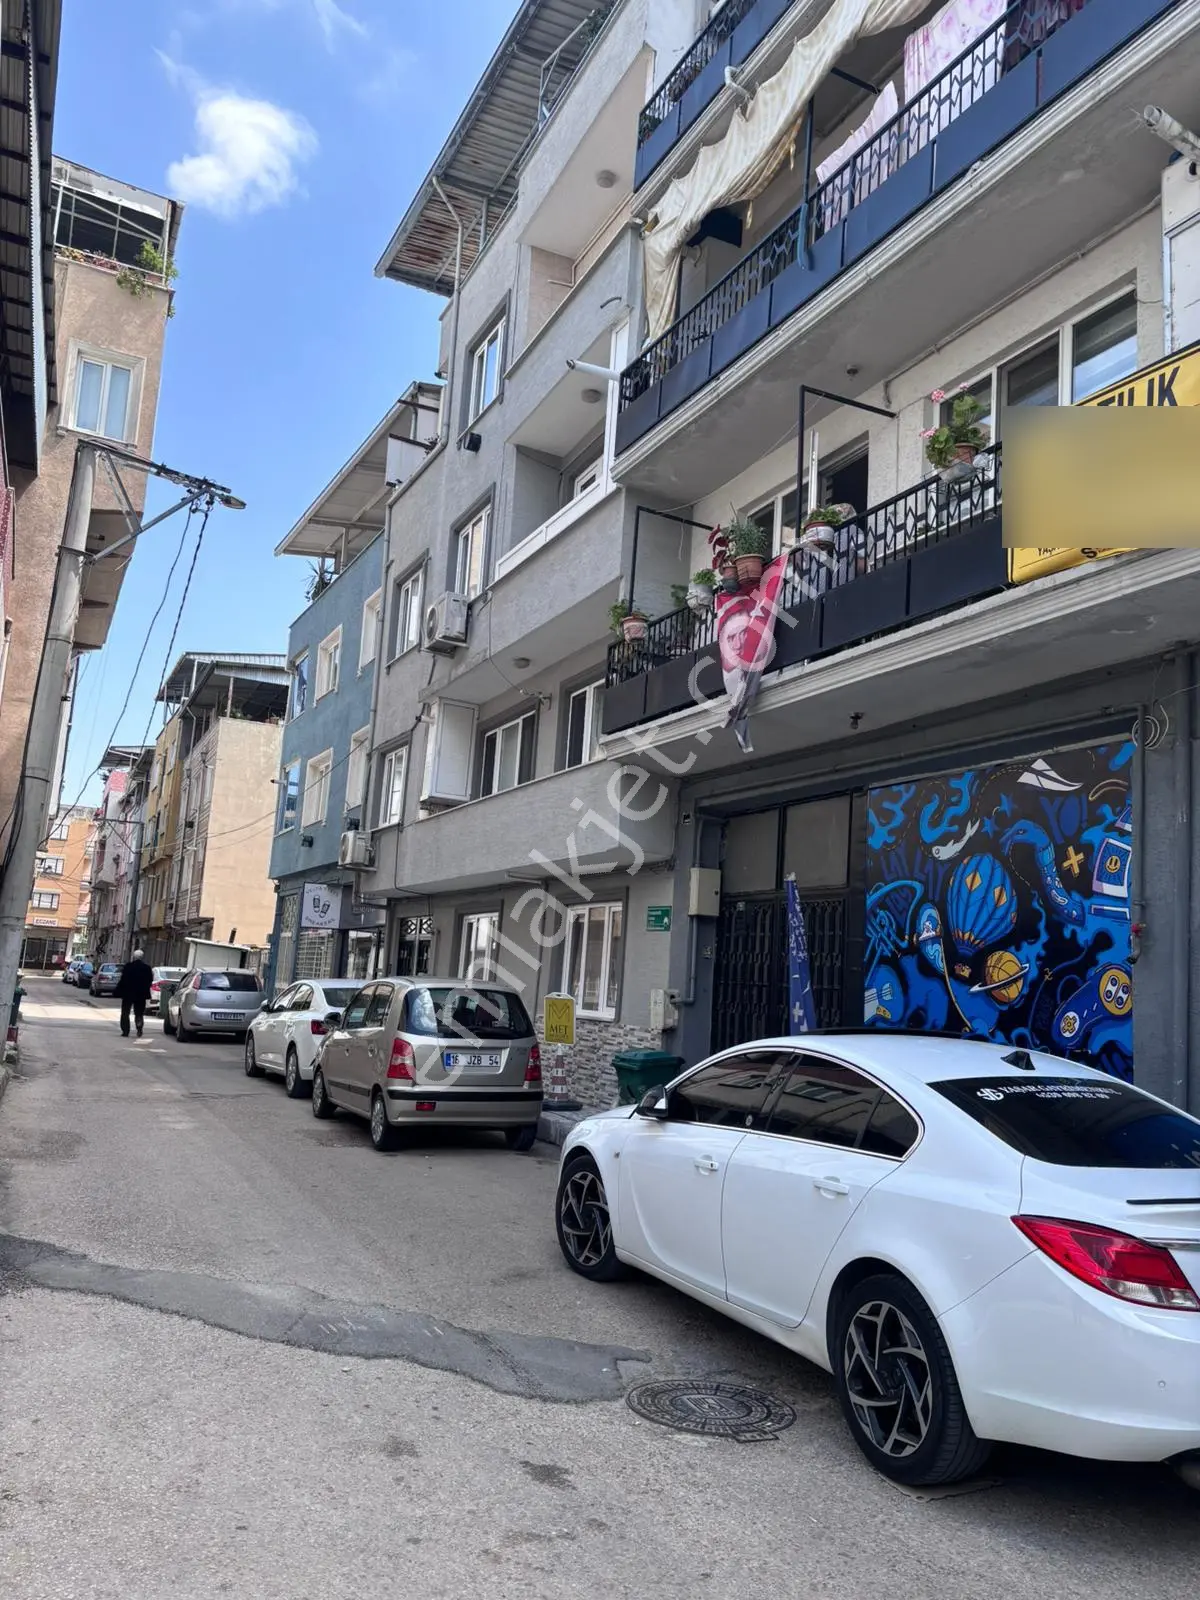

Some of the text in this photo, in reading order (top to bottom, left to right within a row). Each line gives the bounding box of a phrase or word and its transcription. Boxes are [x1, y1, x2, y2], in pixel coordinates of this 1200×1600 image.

[550, 1023, 569, 1035] MET
[467, 1055, 482, 1066] JZB
[488, 1055, 499, 1066] 54
